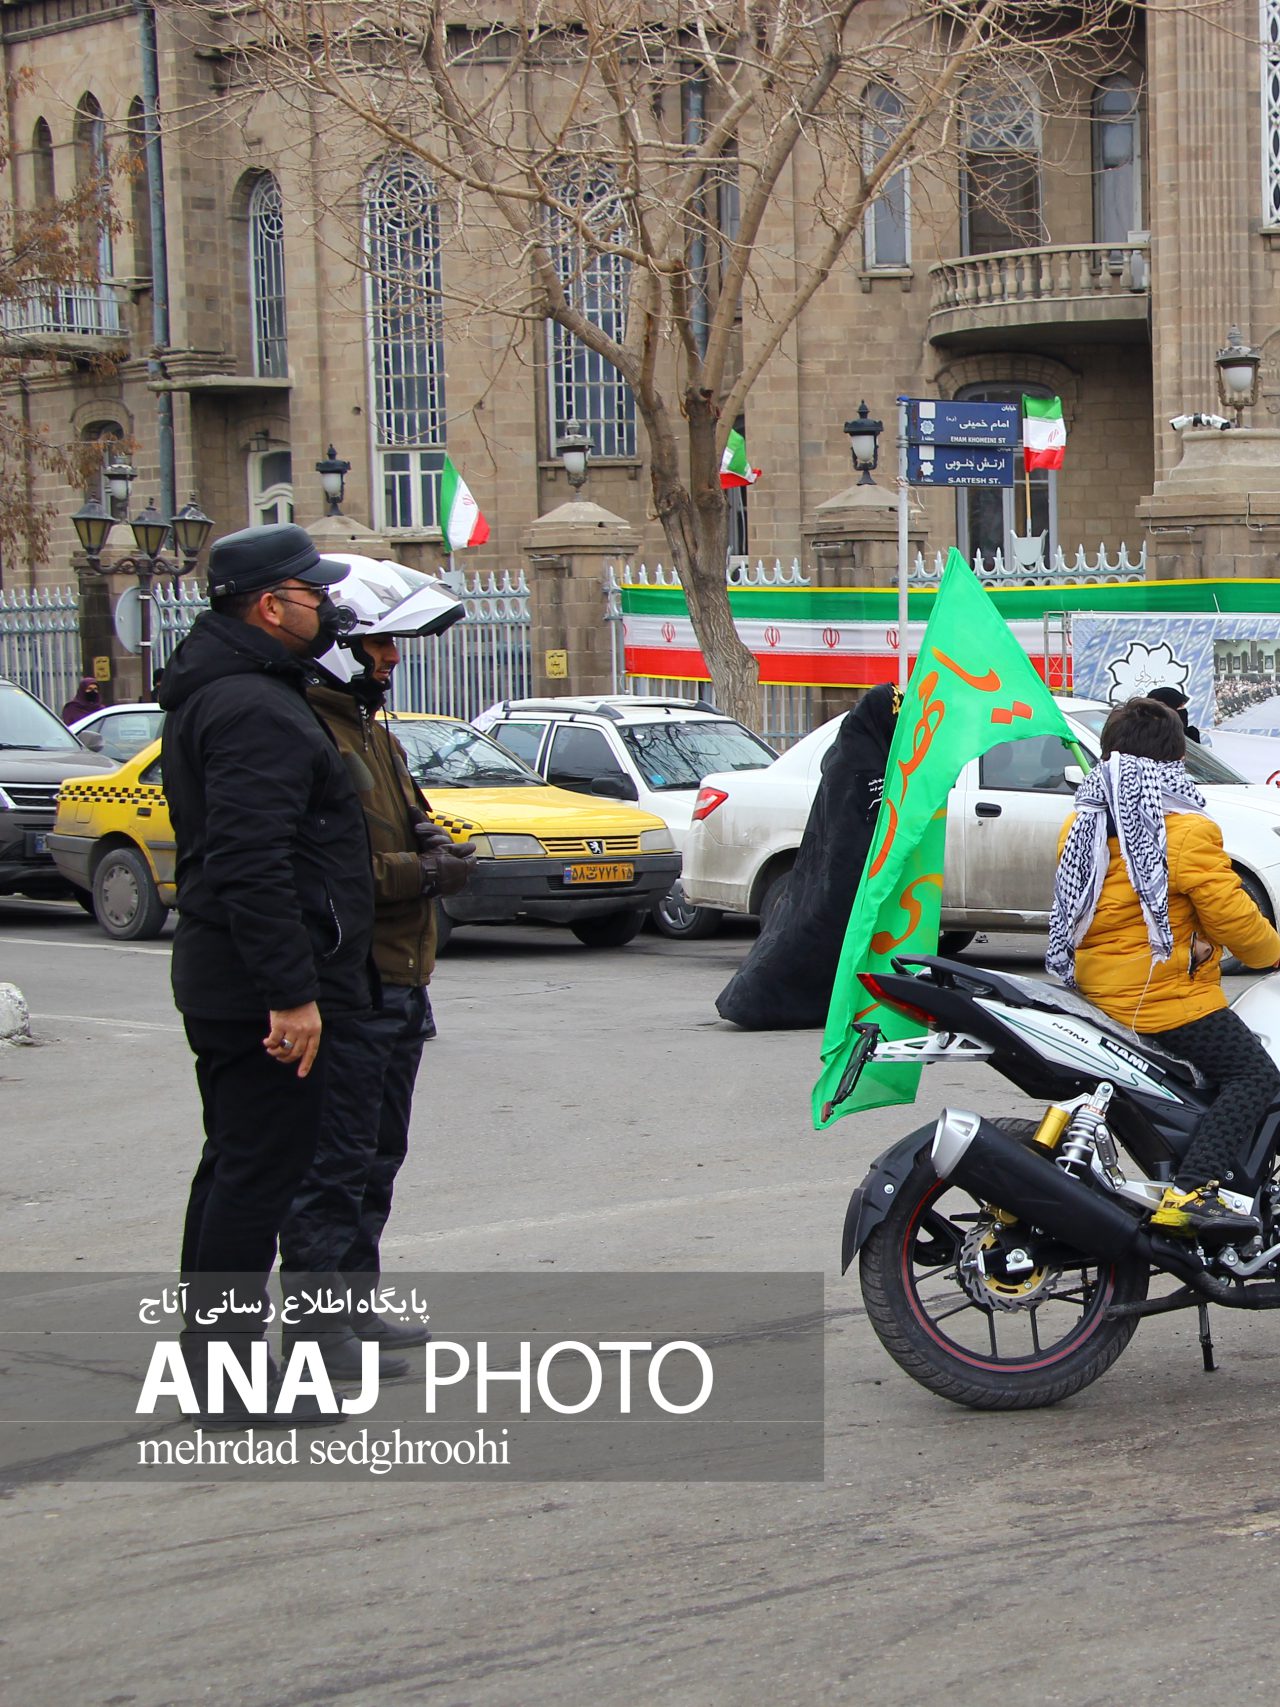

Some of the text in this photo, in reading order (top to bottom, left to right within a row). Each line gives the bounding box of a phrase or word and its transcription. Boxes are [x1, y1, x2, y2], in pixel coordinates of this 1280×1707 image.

[959, 419, 989, 430] خمینی
[990, 419, 1010, 432] امام
[945, 457, 1006, 472] ارتش جنوبی
[1052, 1021, 1089, 1045] NAMI
[1105, 1040, 1150, 1073] NAMI
